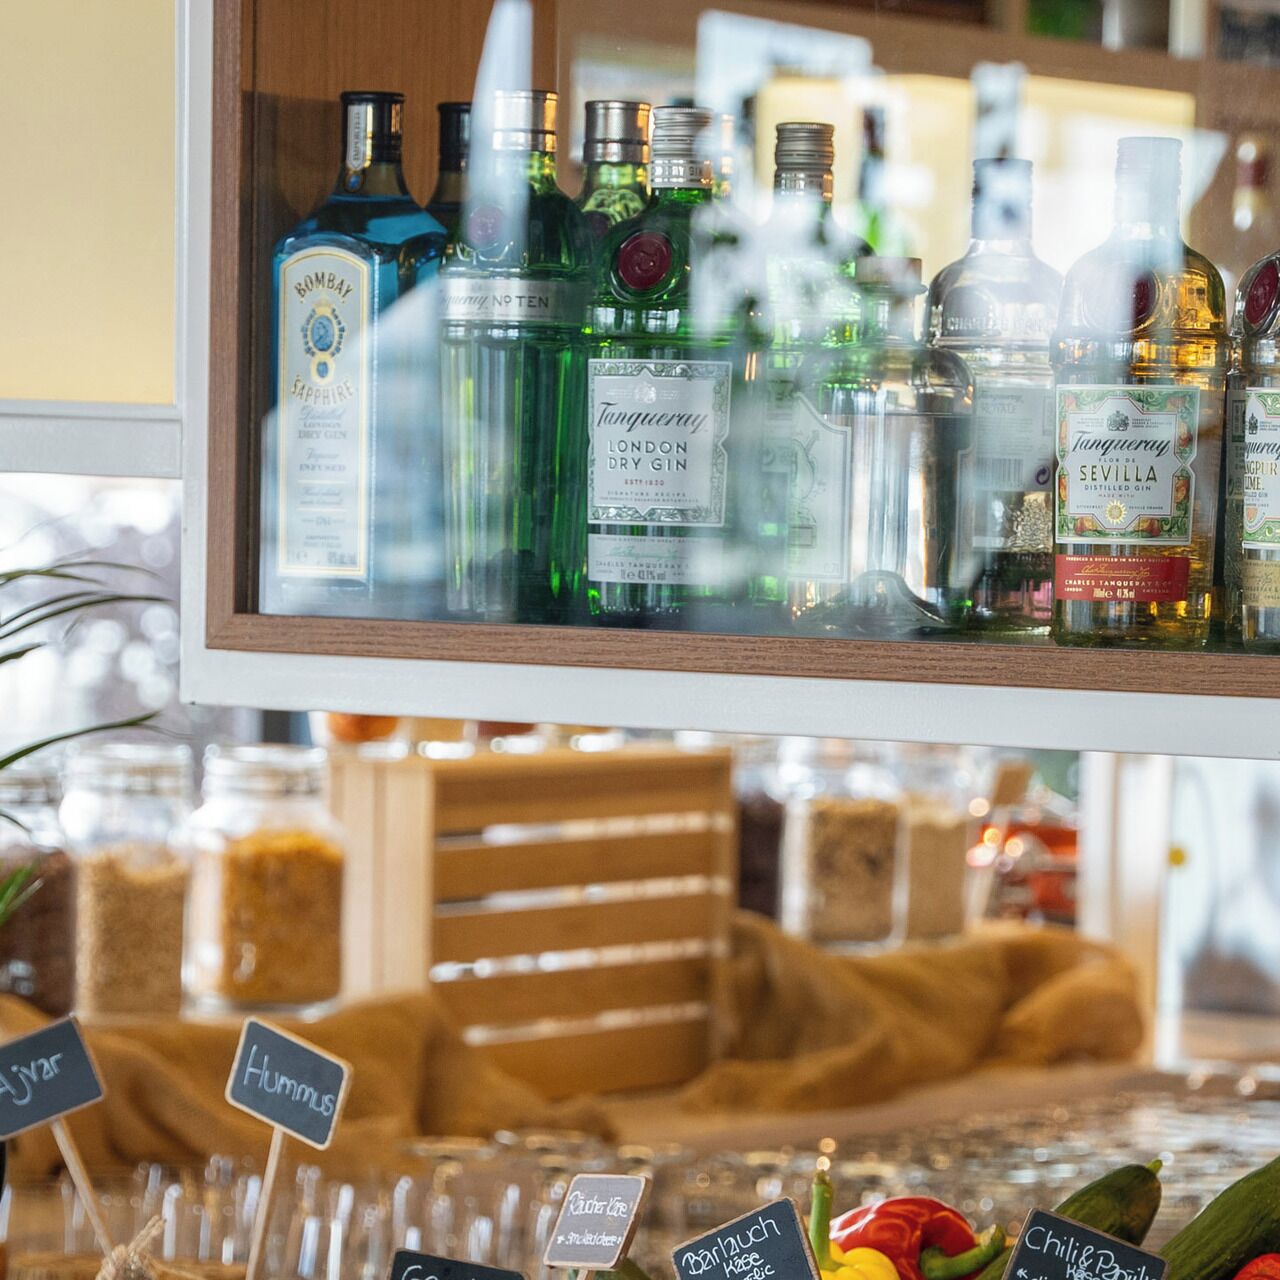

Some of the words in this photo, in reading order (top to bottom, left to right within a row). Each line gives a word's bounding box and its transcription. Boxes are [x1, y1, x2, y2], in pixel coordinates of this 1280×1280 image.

[294, 271, 353, 298] BOMBAY
[515, 295, 549, 308] TEN
[291, 378, 354, 406] SAPPHIRE
[597, 402, 708, 434] Tanqueray
[607, 440, 688, 454] LONDON
[1072, 430, 1171, 457] Tanqueray
[607, 457, 641, 471] DRY
[650, 458, 688, 471] GIN
[1079, 465, 1158, 483] SEVILLA
[243, 1044, 335, 1118] Hummus
[723, 1252, 765, 1279] Käse
